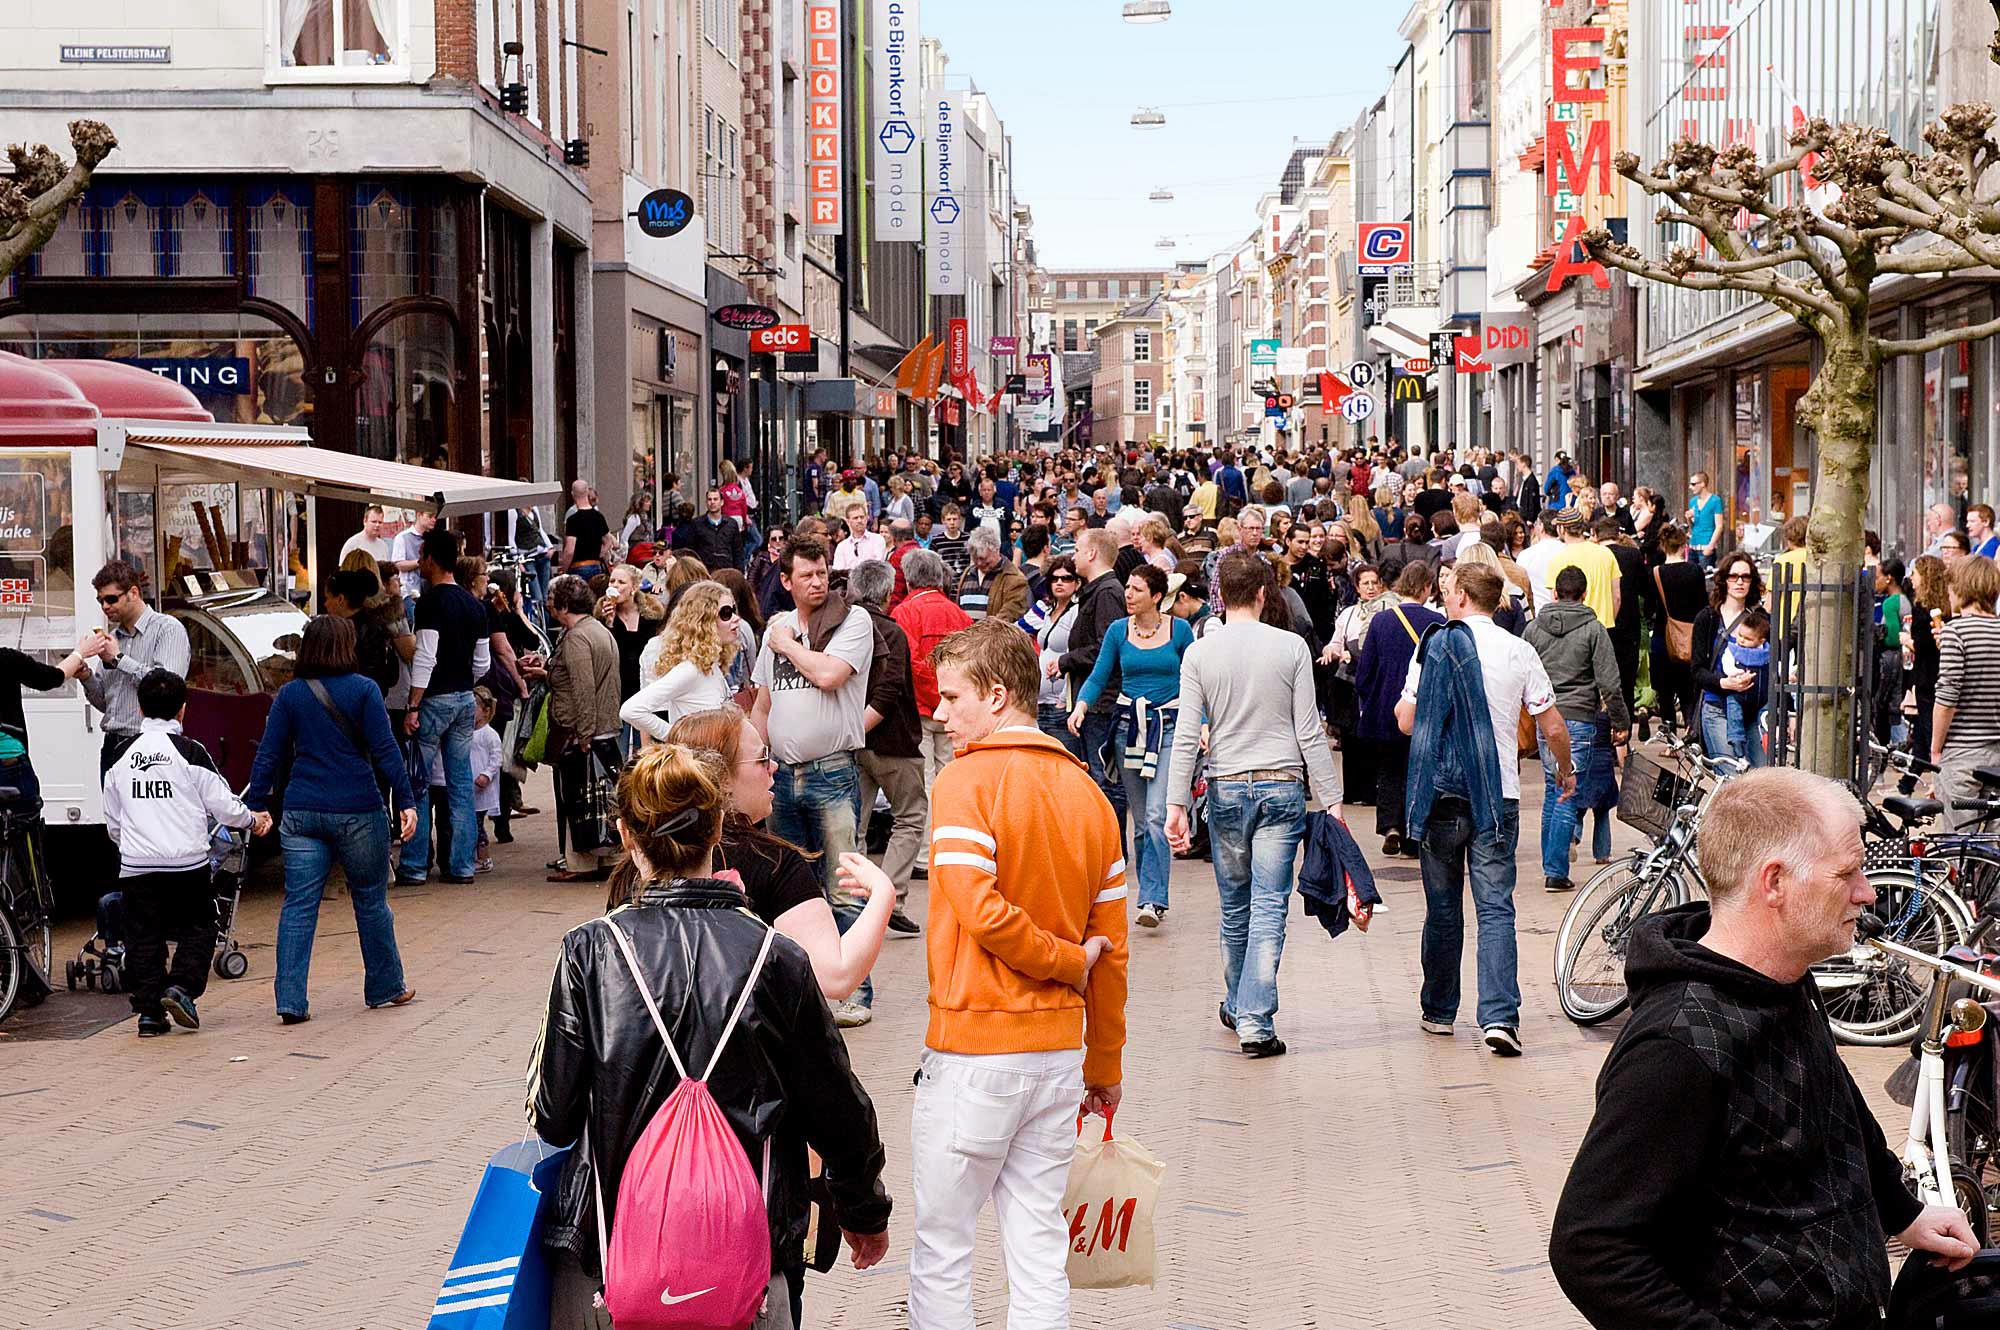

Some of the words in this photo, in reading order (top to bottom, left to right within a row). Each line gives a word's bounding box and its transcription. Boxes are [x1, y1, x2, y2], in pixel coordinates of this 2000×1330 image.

[63, 48, 95, 59] KLEINE
[96, 48, 167, 59] PELSTERSTRAAT
[815, 10, 834, 220] BLOKKER
[1545, 0, 1611, 291] EMA
[890, 163, 906, 228] mode
[939, 232, 952, 284] mode
[1364, 227, 1404, 260] C
[760, 326, 800, 345] edc
[953, 328, 963, 364] Kruidvat
